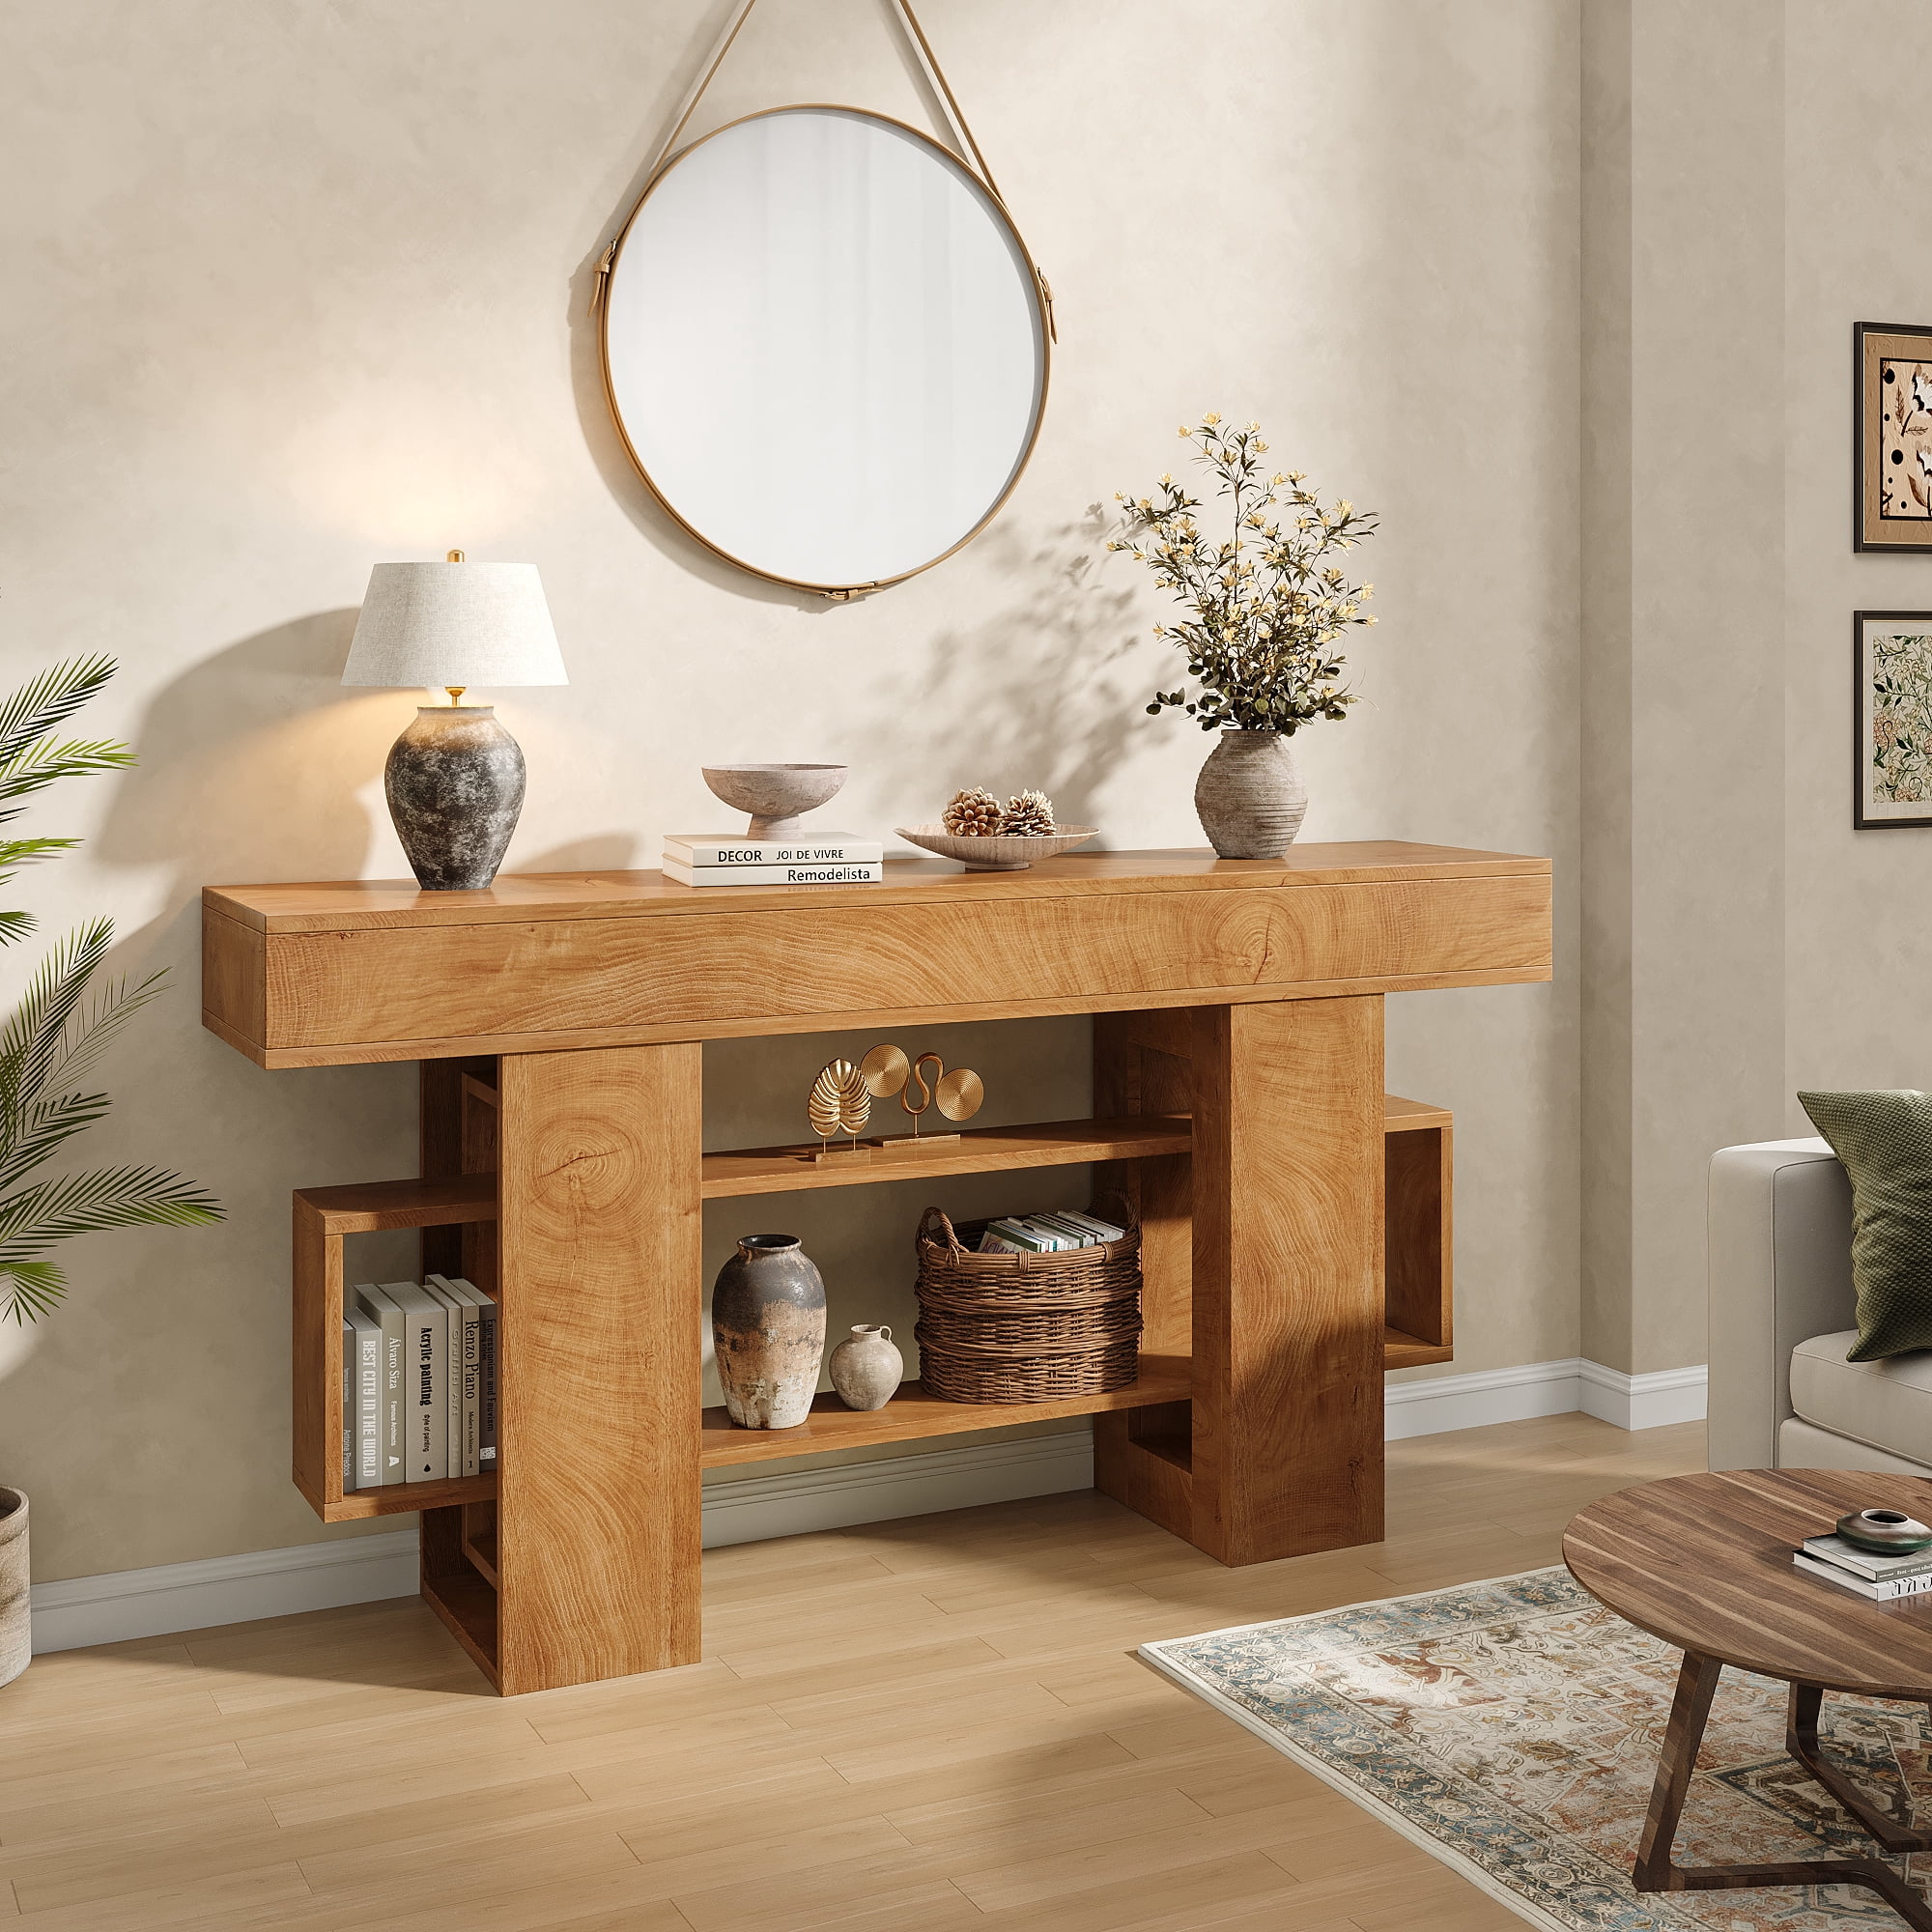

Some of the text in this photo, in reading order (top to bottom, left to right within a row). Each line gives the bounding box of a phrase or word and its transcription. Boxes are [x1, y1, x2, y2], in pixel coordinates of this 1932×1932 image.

[718, 849, 844, 863] DECOR JOI DE VIVRE
[787, 867, 870, 882] Remodelista
[362, 1340, 376, 1368] BEST
[388, 1337, 401, 1389] Álvaro Siza
[419, 1327, 433, 1406] Acrylic painting
[465, 1320, 479, 1399] Renzo Piano
[362, 1370, 376, 1396] CITY
[486, 1380, 497, 1396] and
[362, 1413, 376, 1435] THE
[486, 1397, 497, 1432] Fauvism
[343, 1429, 352, 1477] Antoine Predock
[362, 1437, 376, 1476] WORLD
